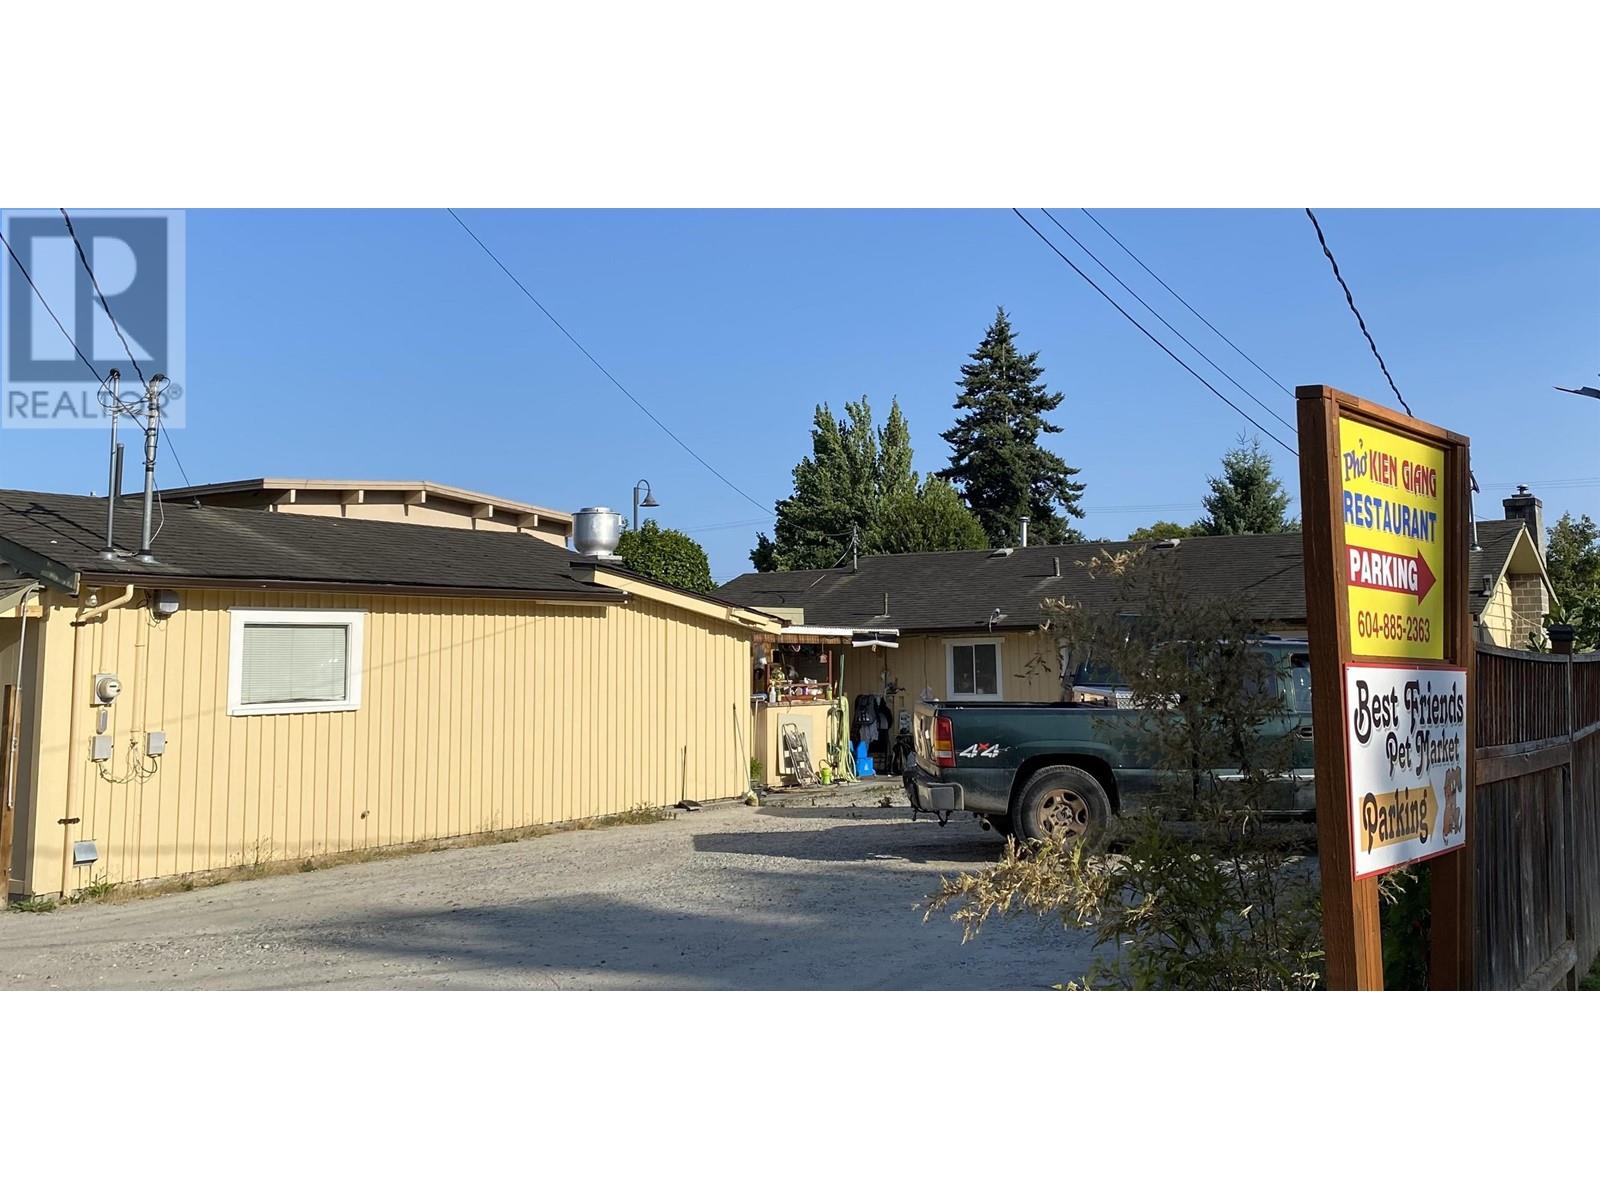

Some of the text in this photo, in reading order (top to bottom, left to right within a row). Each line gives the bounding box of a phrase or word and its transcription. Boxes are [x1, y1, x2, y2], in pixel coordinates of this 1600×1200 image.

[1369, 449, 1398, 489] KIEN
[1401, 459, 1437, 498] GIANG
[1343, 489, 1437, 543] RESTAURANT
[1349, 548, 1418, 592] PARKING
[1357, 609, 1431, 643] 604-885-2363
[1354, 680, 1464, 744] Best Friends
[1386, 729, 1460, 777] Pet Market
[1362, 786, 1428, 854] Parking
